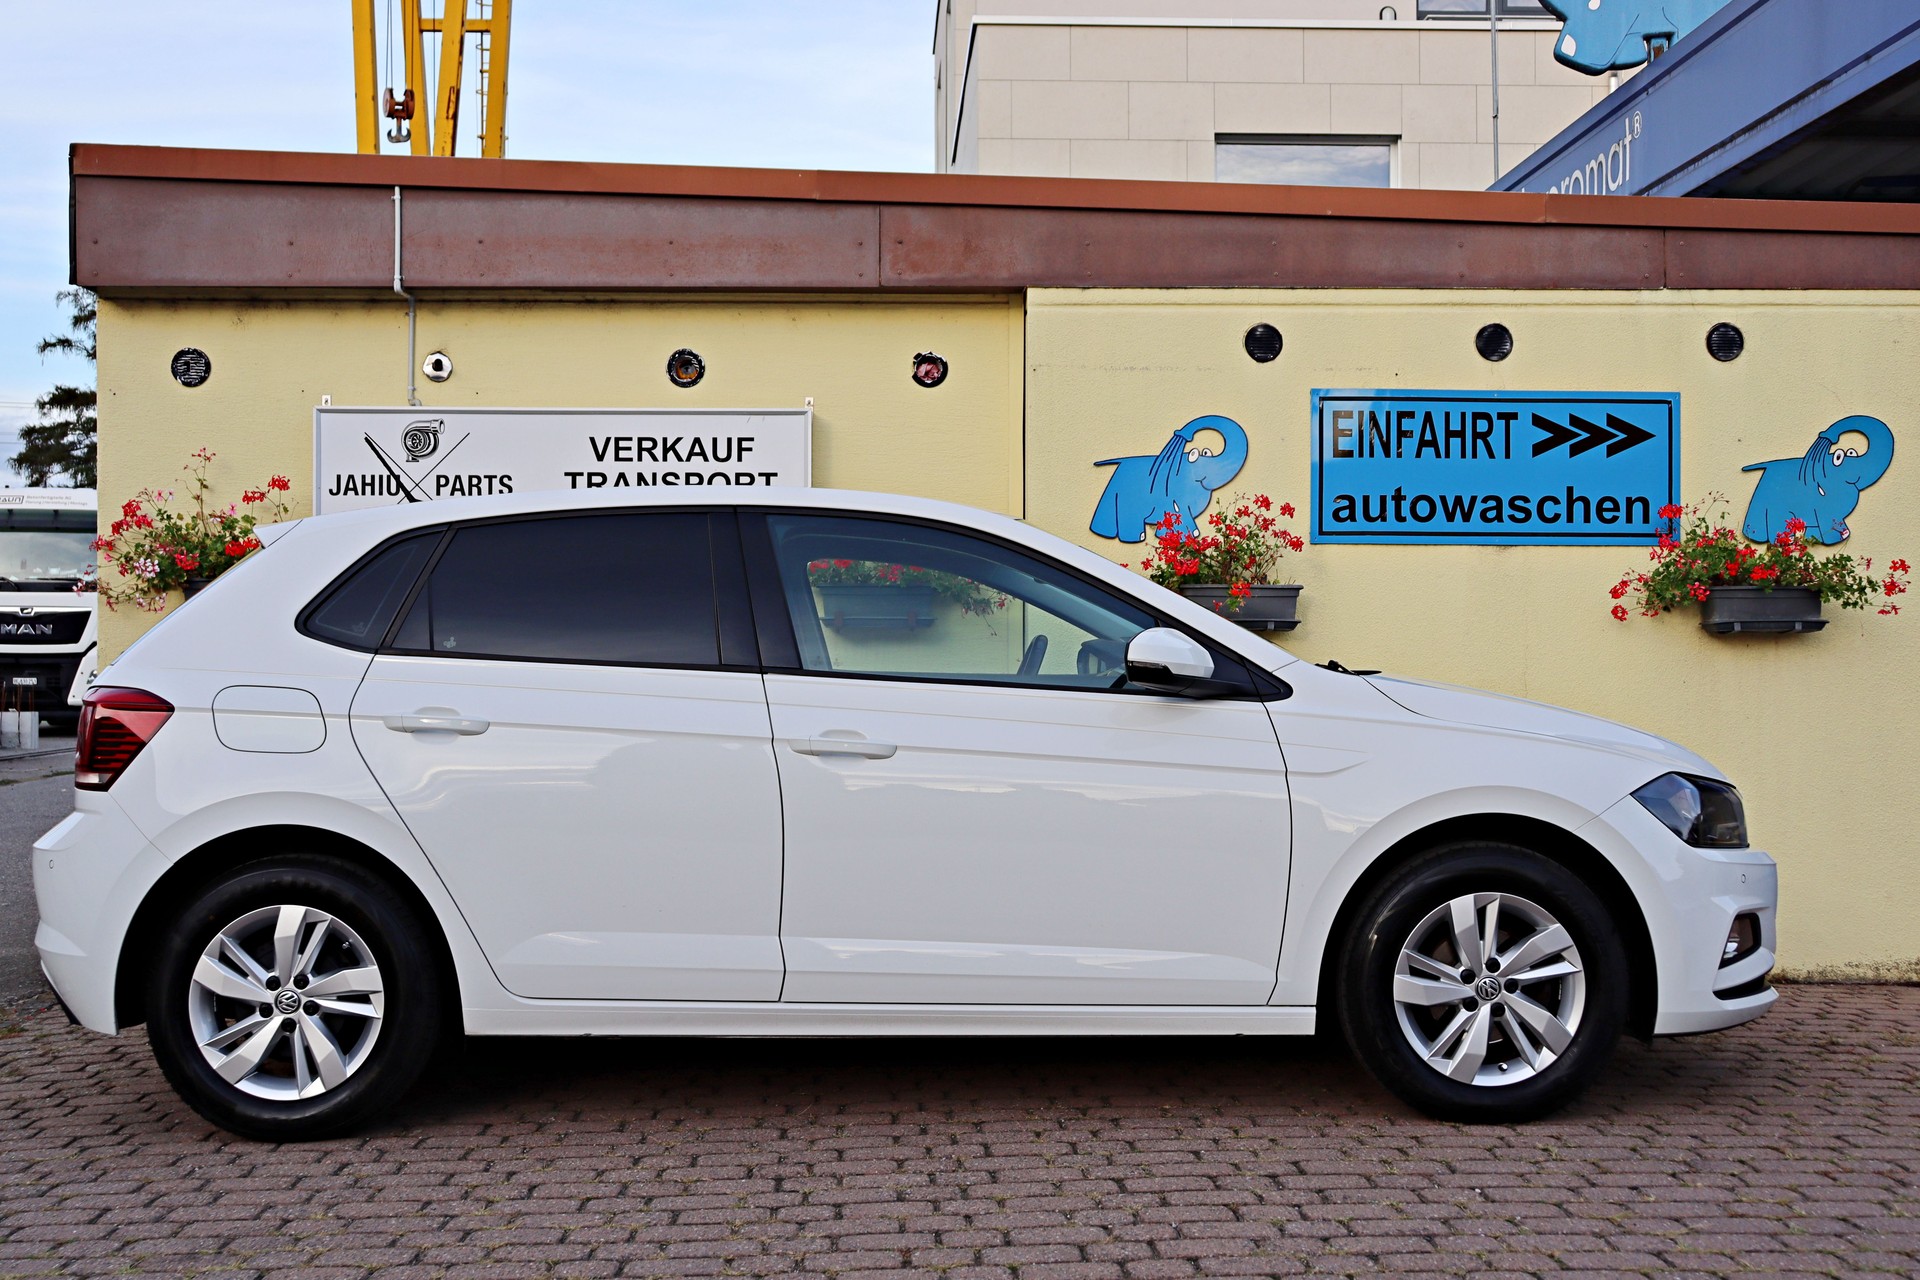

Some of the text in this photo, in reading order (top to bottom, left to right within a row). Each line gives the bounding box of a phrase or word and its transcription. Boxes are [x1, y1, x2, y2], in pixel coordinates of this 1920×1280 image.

[1332, 410, 1519, 460] EINFAHRT
[588, 436, 755, 463] VERKAUF
[435, 474, 514, 497] PARTS
[1331, 485, 1651, 525] autowaschen
[0, 623, 53, 635] MAN
